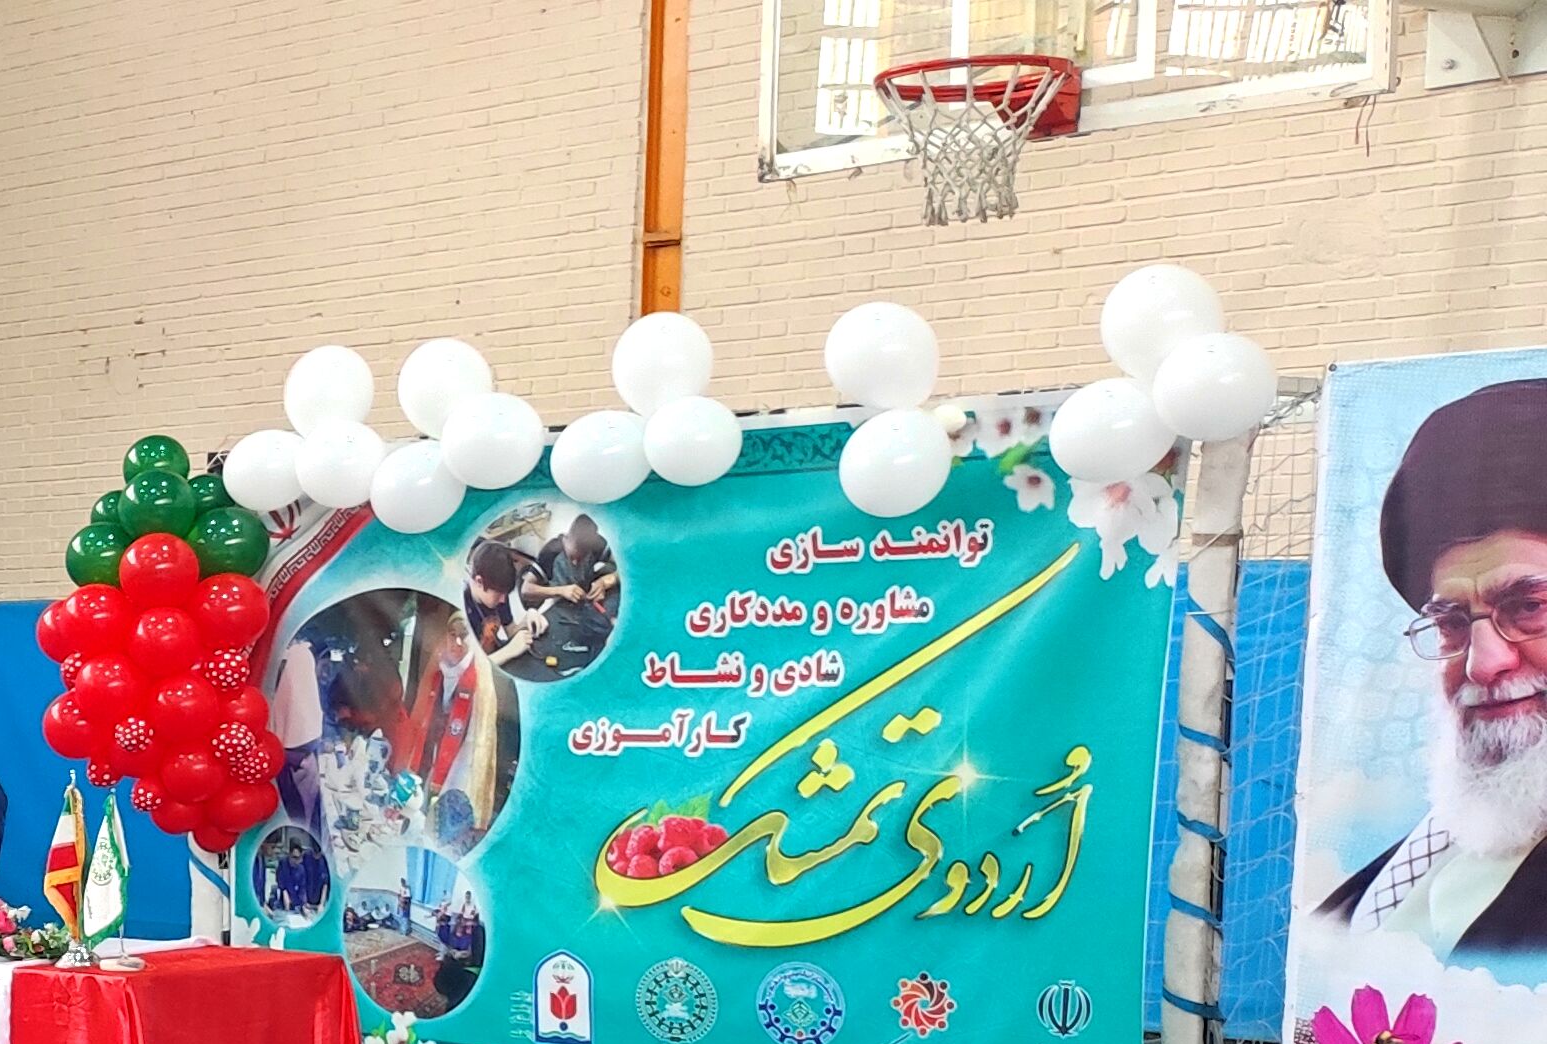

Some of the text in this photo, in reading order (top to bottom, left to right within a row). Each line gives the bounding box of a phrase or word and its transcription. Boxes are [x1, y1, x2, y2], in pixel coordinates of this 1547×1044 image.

[770, 521, 992, 570] توانمند سازی
[689, 589, 931, 635] مشاوره و مددکاری
[645, 651, 841, 692] شادی و نشاط
